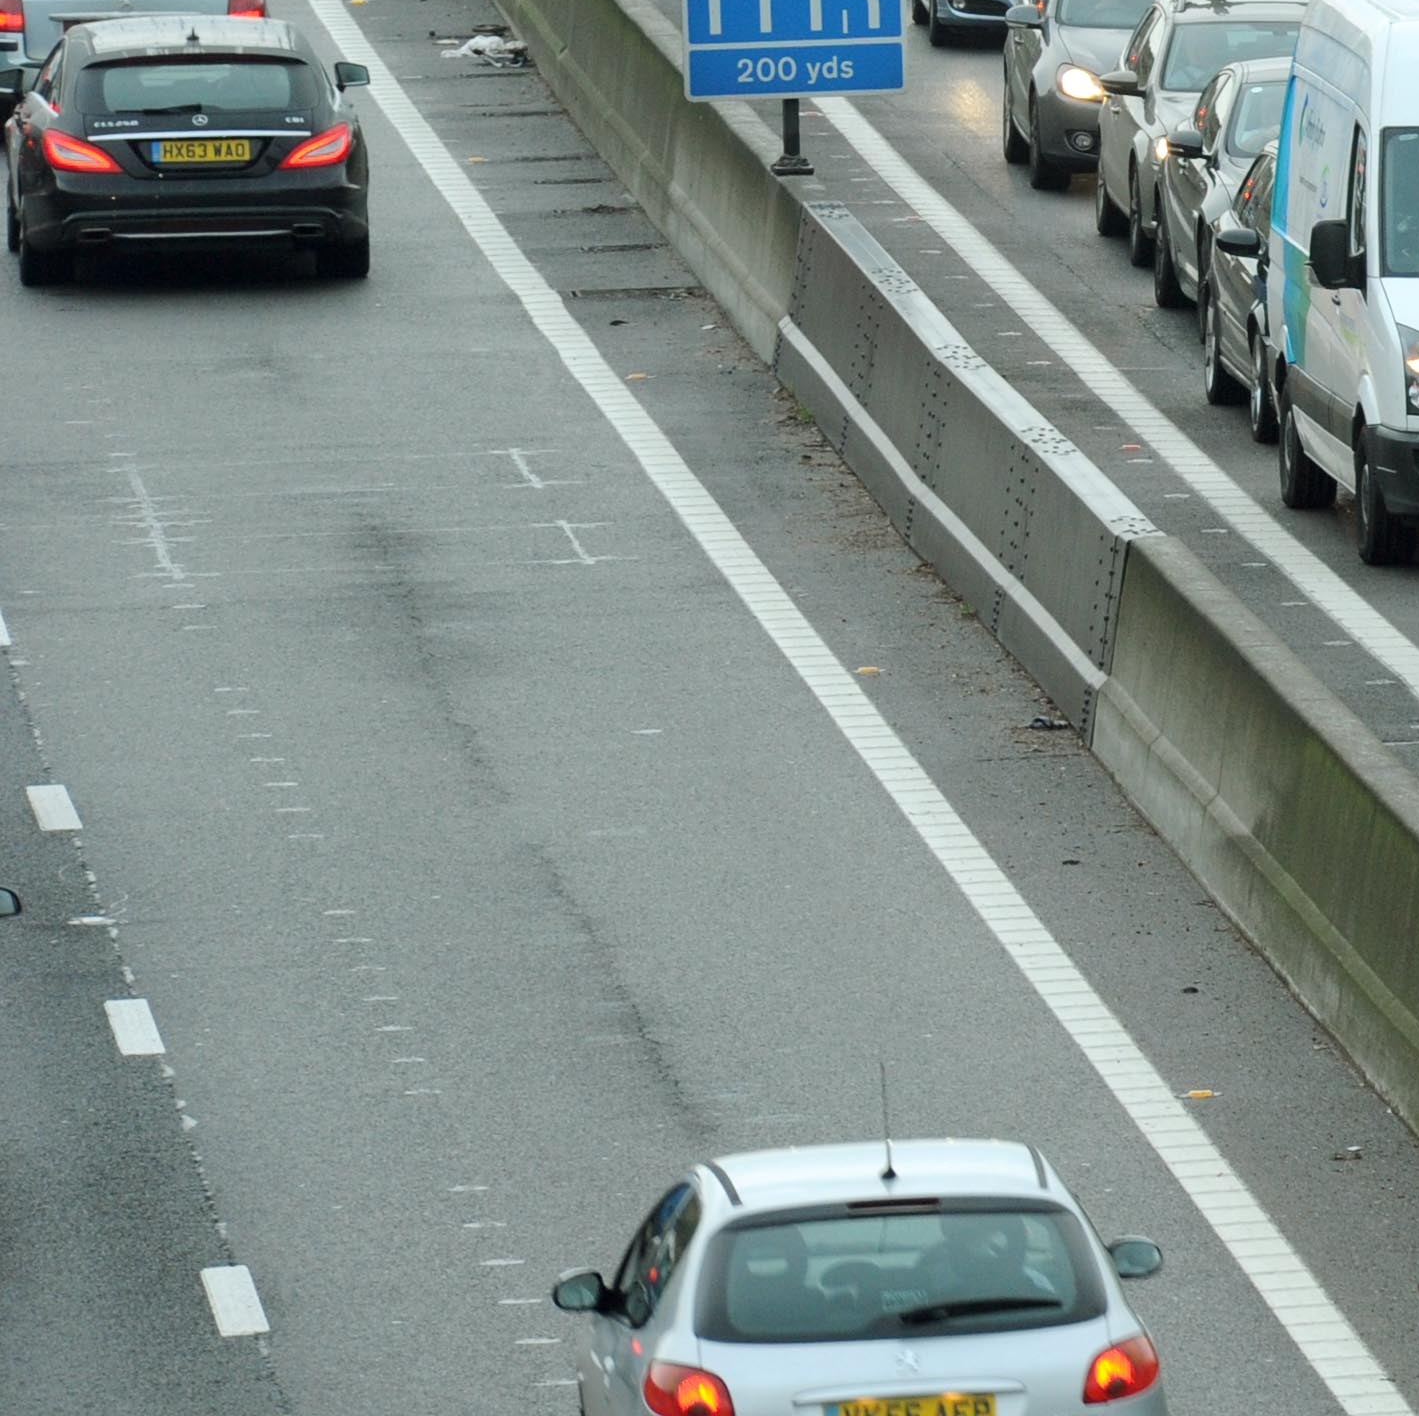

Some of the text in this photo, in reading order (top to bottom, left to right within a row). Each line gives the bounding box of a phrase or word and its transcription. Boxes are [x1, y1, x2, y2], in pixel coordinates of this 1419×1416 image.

[737, 55, 855, 84] 200 yds
[163, 143, 207, 159] HX63
